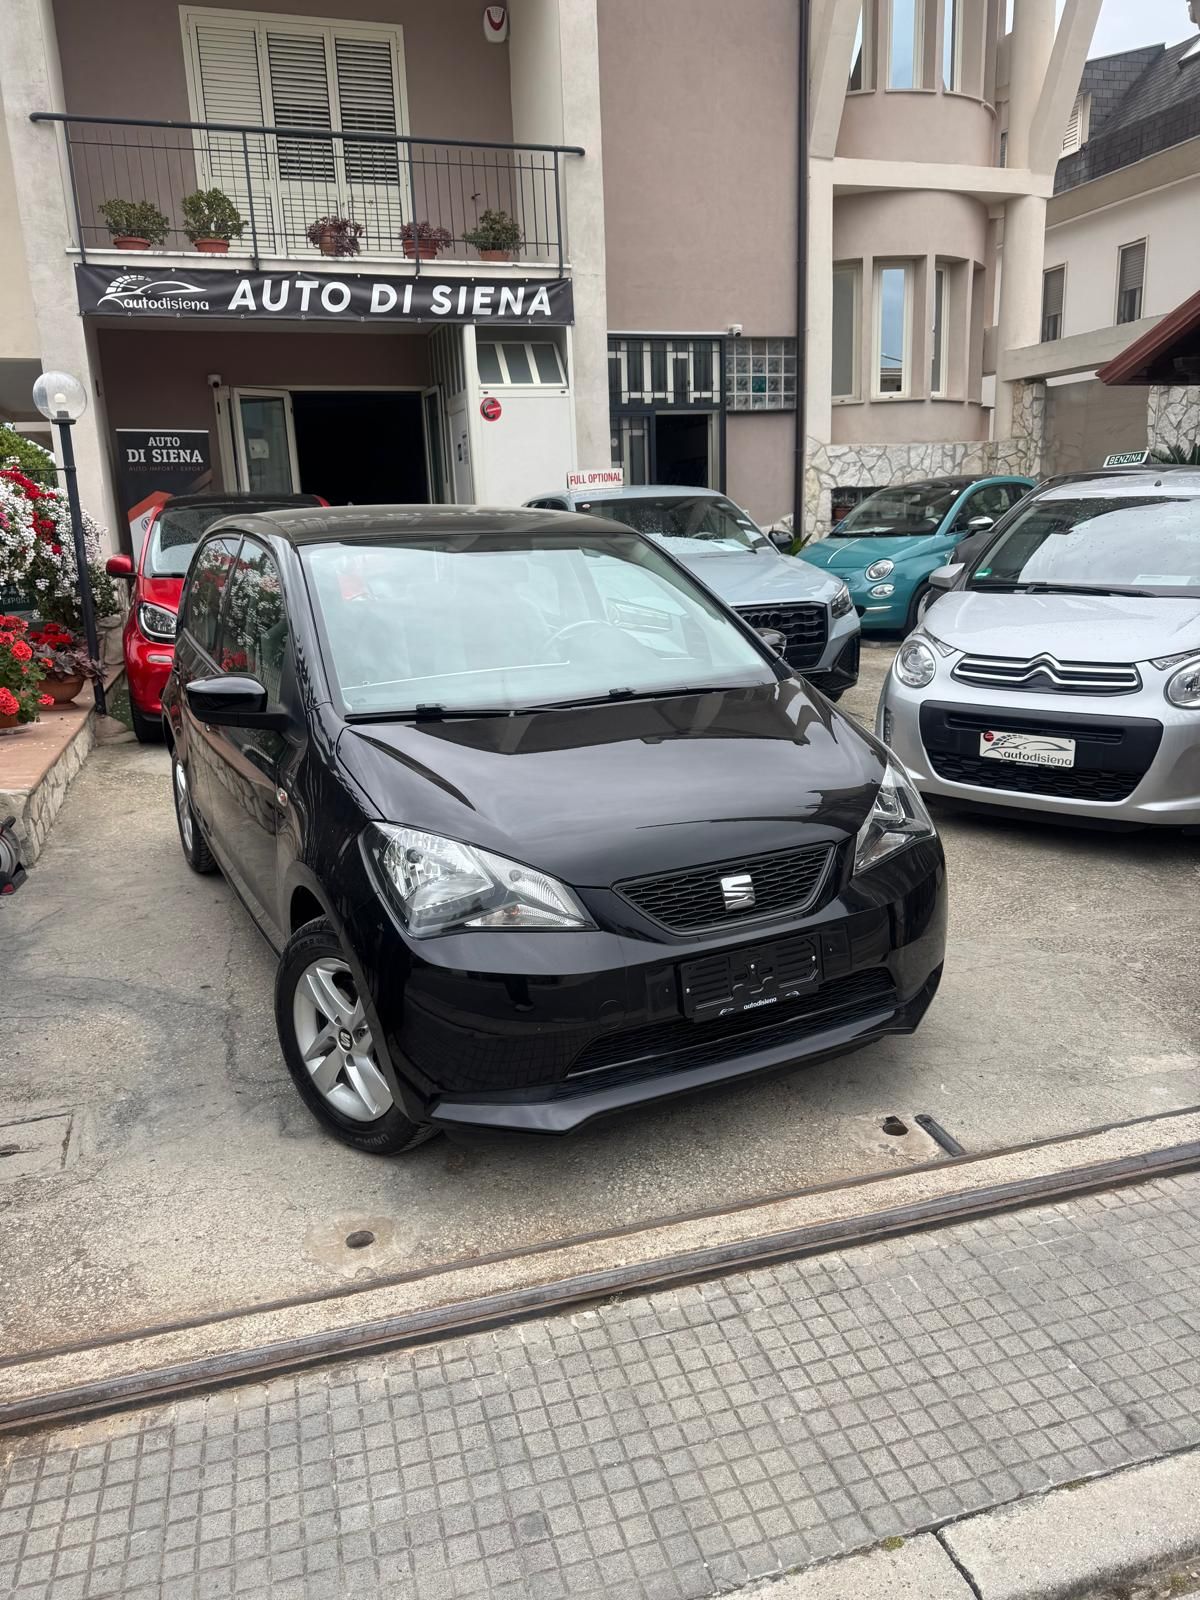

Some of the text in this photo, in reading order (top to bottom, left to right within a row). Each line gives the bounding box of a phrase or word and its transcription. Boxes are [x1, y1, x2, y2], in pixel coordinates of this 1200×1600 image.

[124, 296, 210, 311] autodisiena
[227, 279, 552, 316] AUTO DI SIENA
[147, 436, 181, 447] AUTO
[126, 448, 204, 463] DI SIENA
[1109, 453, 1141, 465] BENZINA
[570, 472, 622, 485] FULL OPTIONAL
[1003, 751, 1072, 766] autodisiena
[744, 997, 777, 1009] autodisiena
